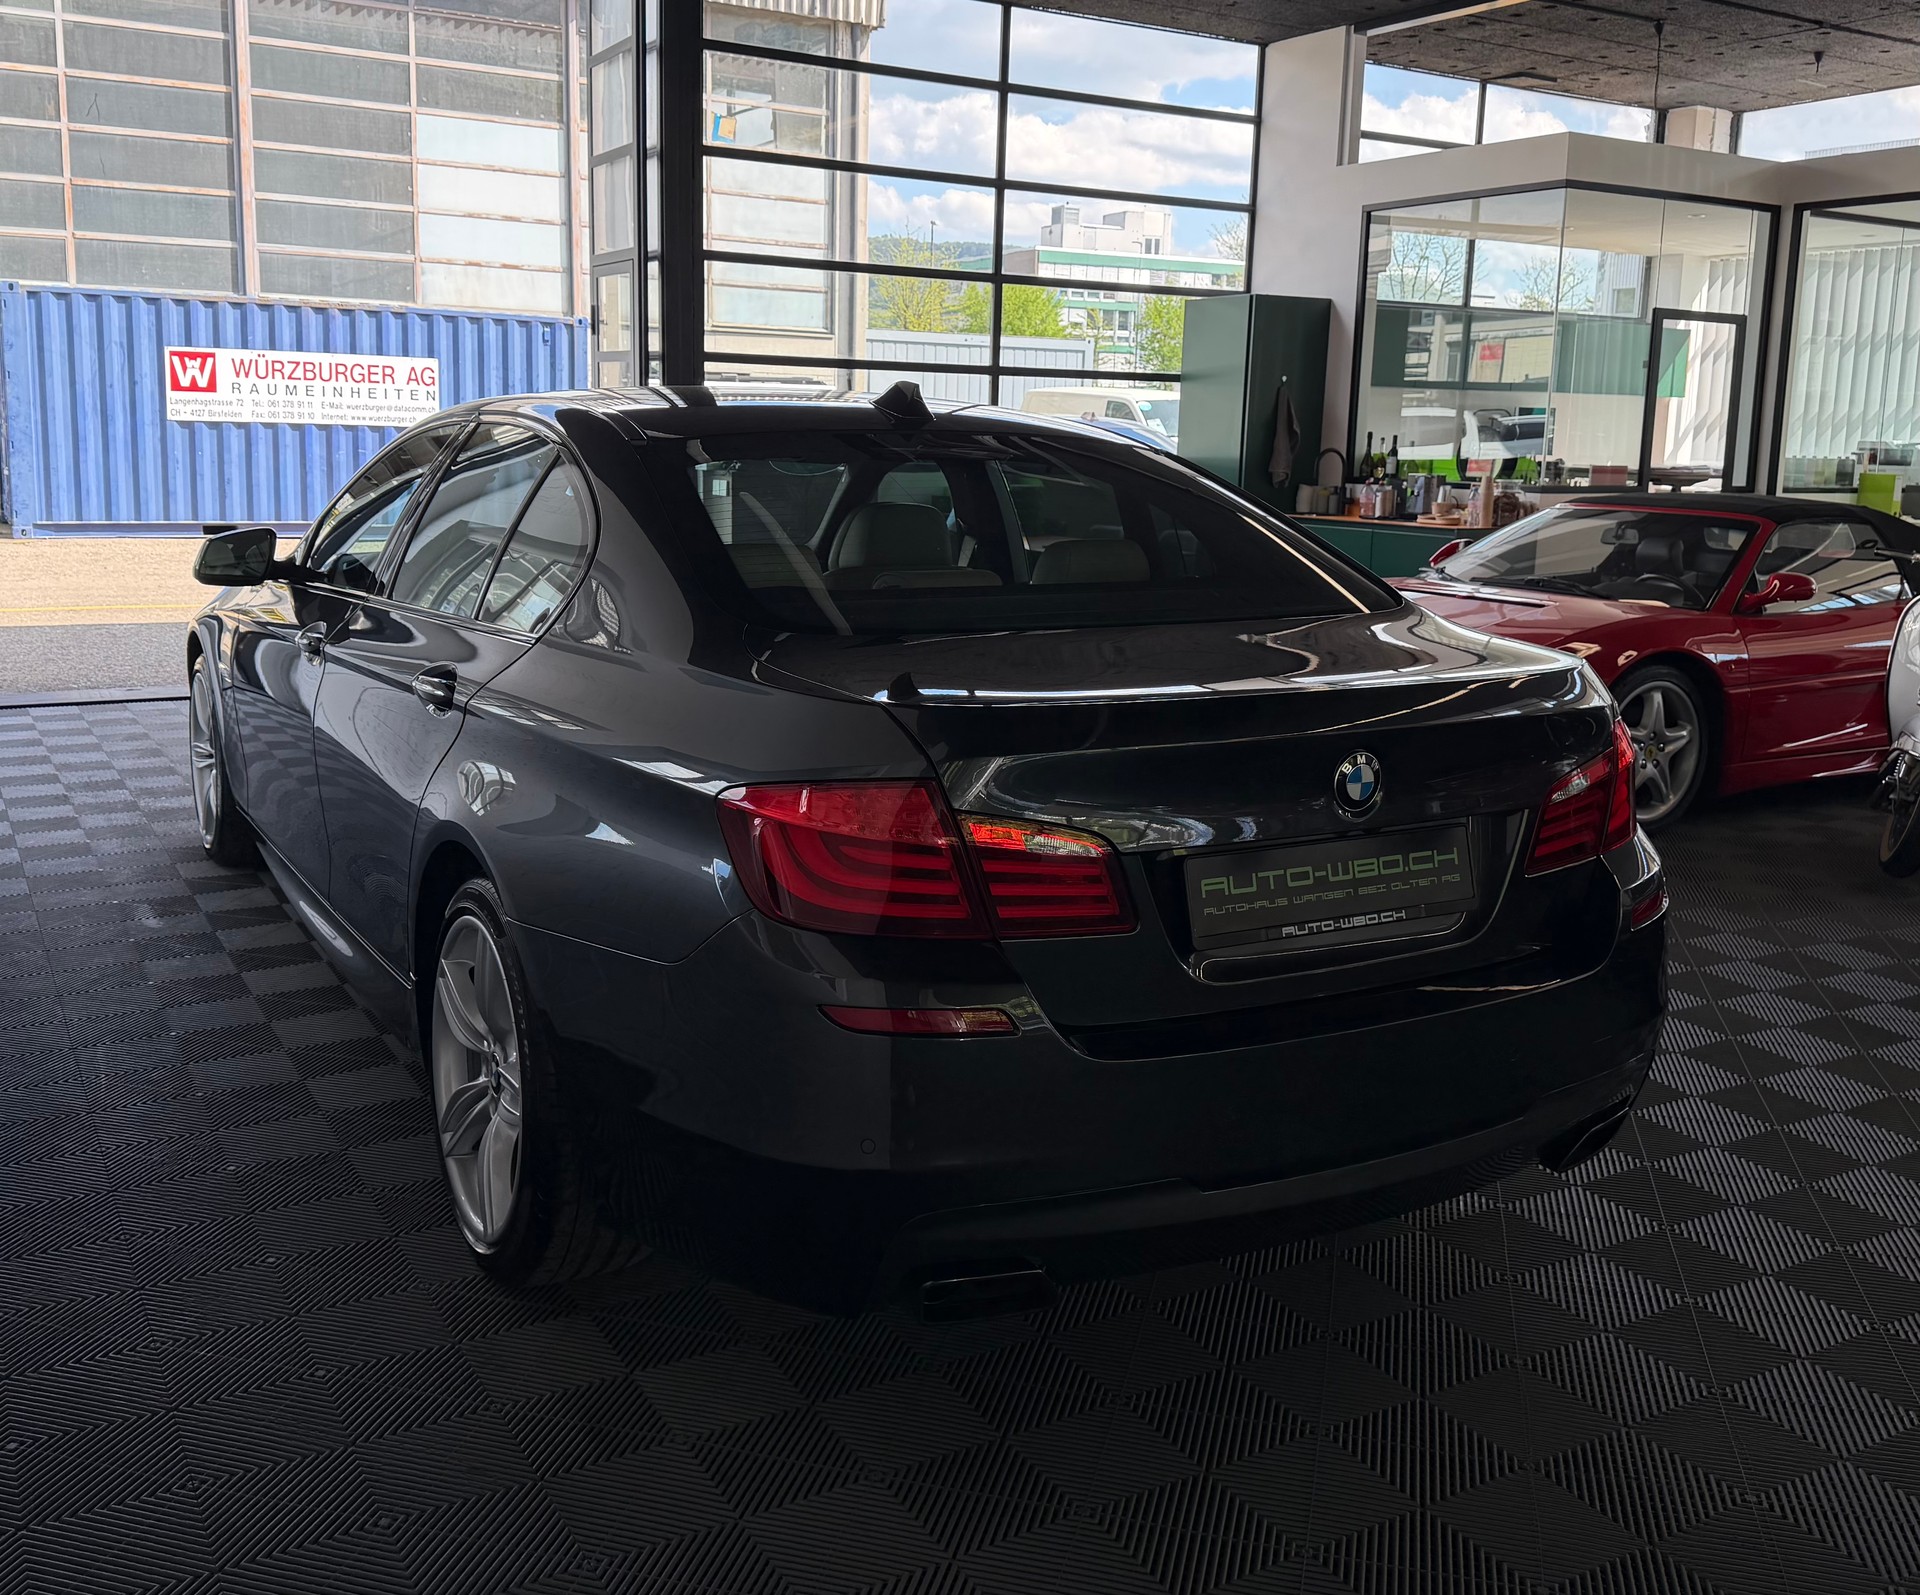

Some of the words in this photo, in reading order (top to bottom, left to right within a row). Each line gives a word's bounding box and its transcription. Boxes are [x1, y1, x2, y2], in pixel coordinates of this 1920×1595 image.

[231, 354, 395, 385] WÜRZBURGER
[406, 366, 436, 387] AG
[231, 382, 436, 401] RAUMEINHEITEN
[169, 396, 234, 408] Langenhagstrasse
[235, 398, 244, 407] 72
[267, 399, 280, 408] 061
[282, 399, 295, 408] 378
[296, 400, 305, 409] 91
[170, 408, 181, 417] CH
[190, 409, 206, 417] 4127
[207, 409, 243, 418] Birsfelden
[267, 410, 280, 419] 061
[282, 411, 295, 419] 378
[296, 411, 305, 419] 91
[307, 412, 315, 420] 10
[1342, 754, 1379, 774] BMW
[1200, 847, 1459, 899] AUTO-WBO.CH
[1203, 897, 1289, 916] AUTOHAUS
[1292, 888, 1355, 904] WANGEN
[1357, 883, 1387, 895] BEI
[1390, 876, 1438, 890] OLTEN
[1441, 873, 1461, 883] AG
[1281, 909, 1407, 938] AUTO-WBO.CH
